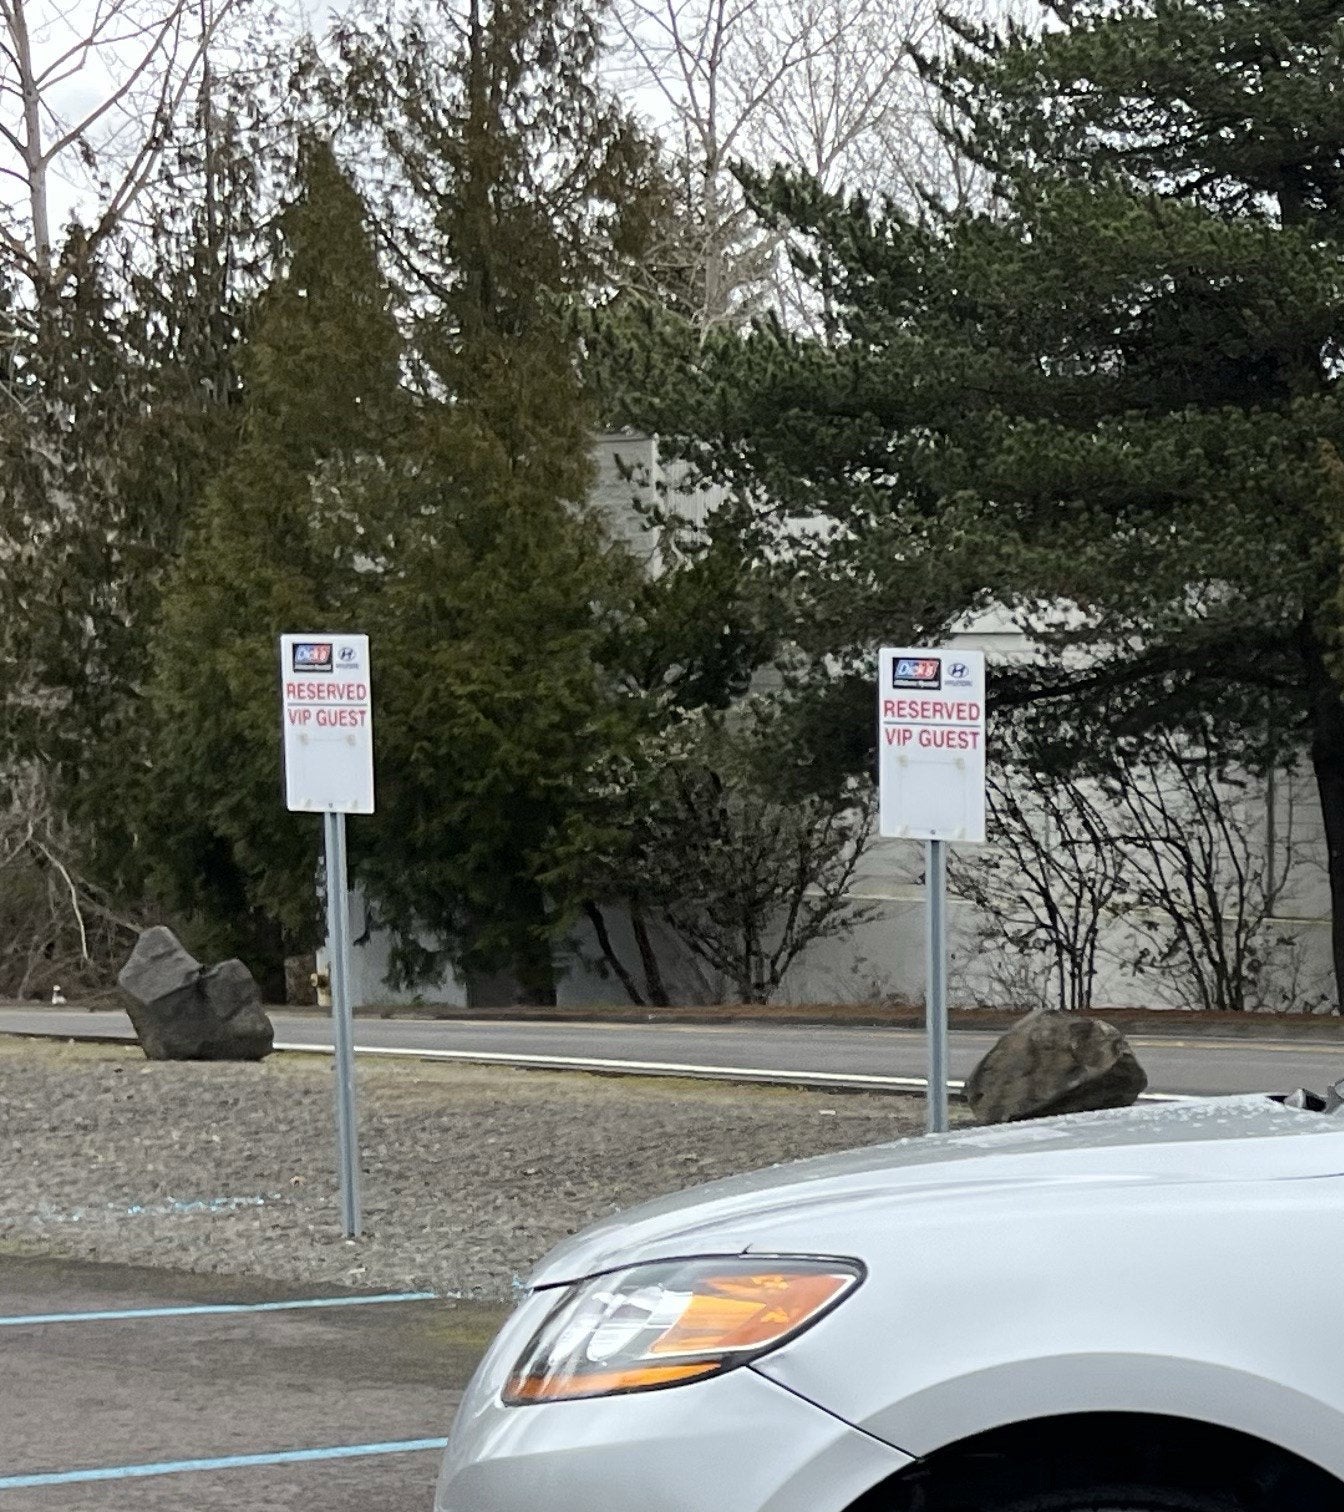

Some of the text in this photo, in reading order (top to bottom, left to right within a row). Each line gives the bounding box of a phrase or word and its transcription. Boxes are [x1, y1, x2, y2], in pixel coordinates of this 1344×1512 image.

[286, 682, 367, 701] RESERVED
[288, 709, 366, 727] VIP GUEST
[883, 700, 981, 721] RESERVED
[885, 728, 980, 750] VIP GUEST
